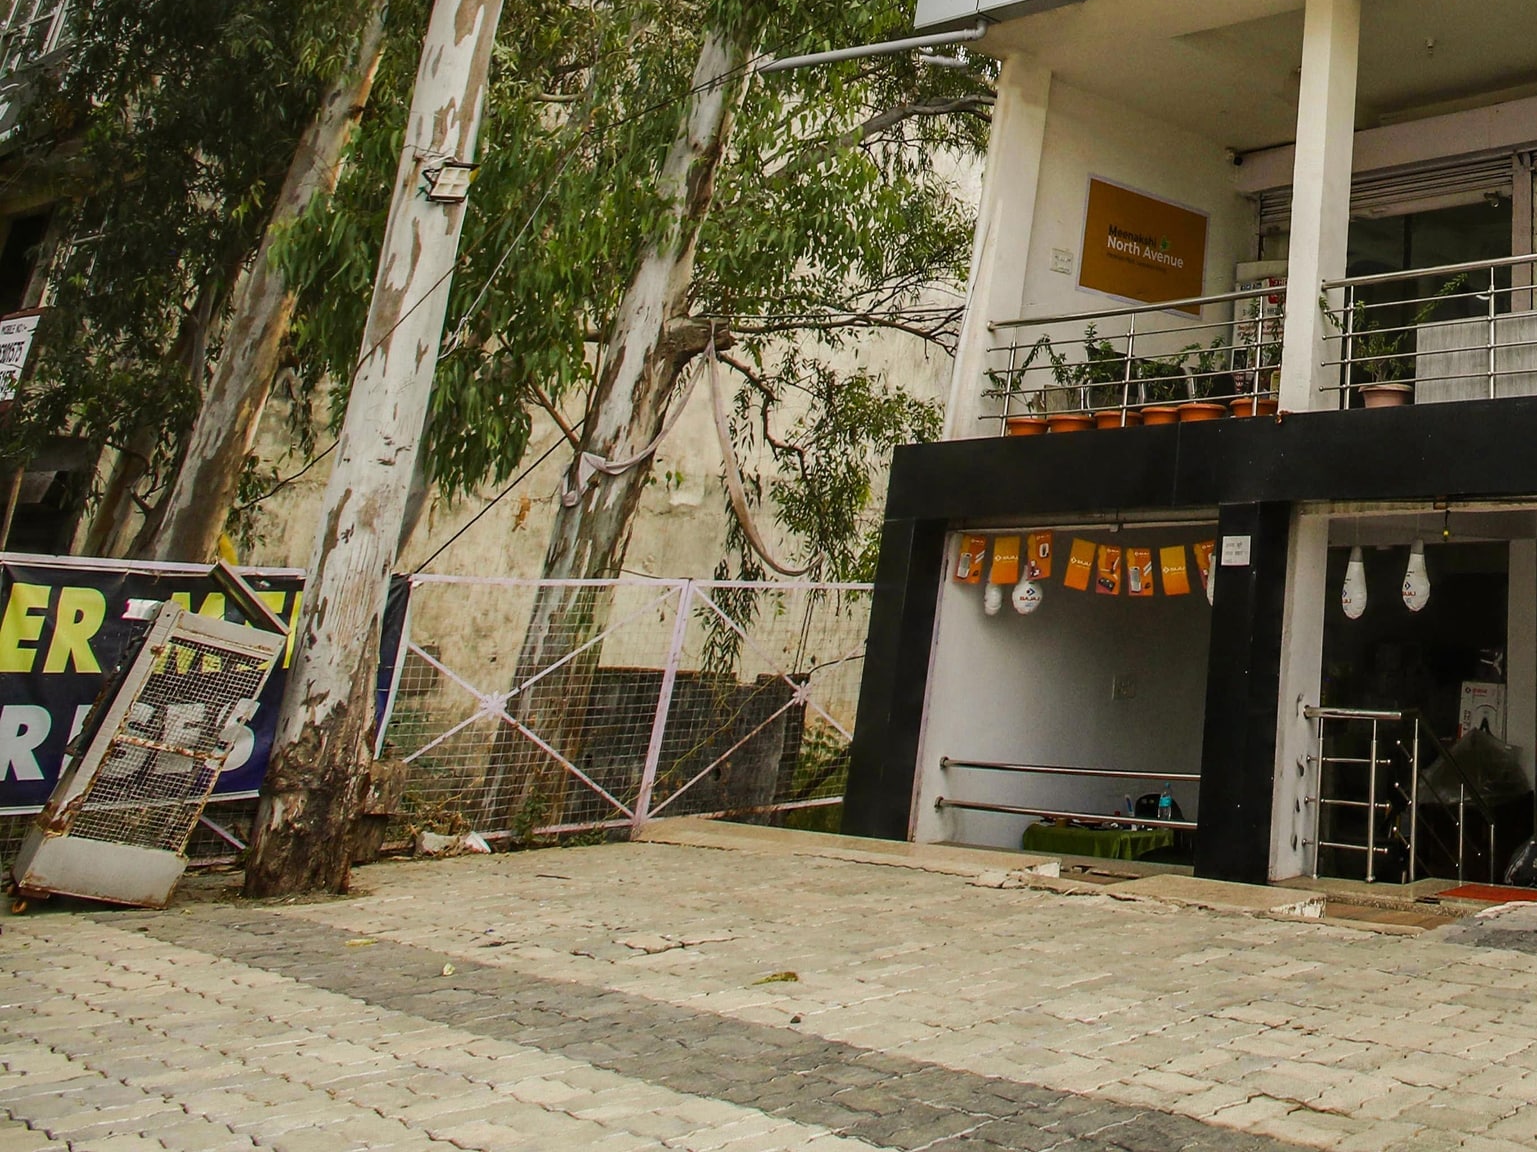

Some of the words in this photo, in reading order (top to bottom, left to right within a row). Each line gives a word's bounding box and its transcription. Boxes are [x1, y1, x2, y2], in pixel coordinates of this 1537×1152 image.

[1108, 223, 1157, 247] Meenakshi
[1107, 235, 1140, 257] North
[1142, 246, 1184, 269] Avenue
